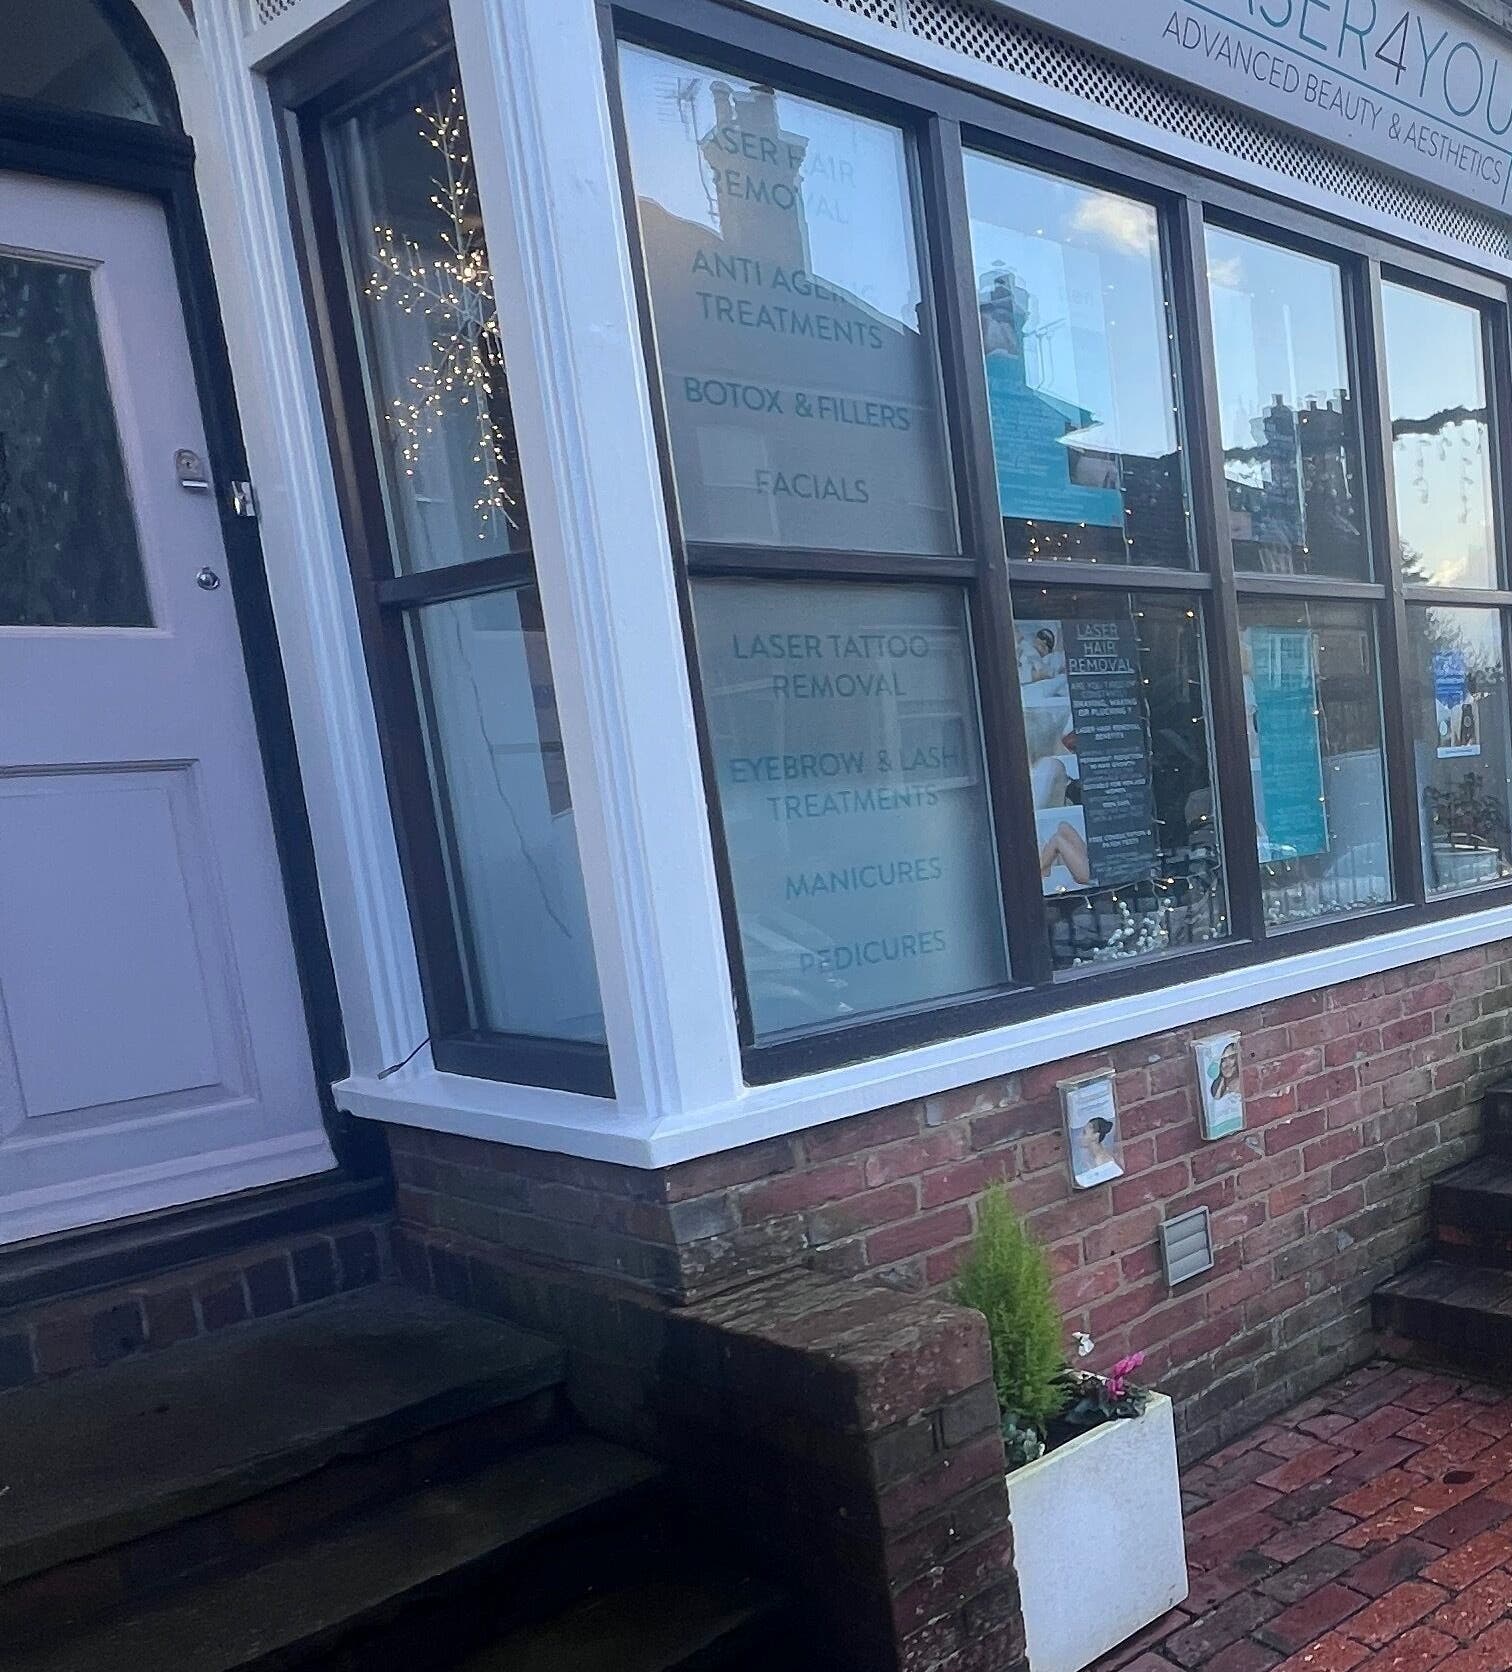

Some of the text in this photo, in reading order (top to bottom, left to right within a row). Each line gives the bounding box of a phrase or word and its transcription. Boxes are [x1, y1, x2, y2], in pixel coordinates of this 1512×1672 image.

[1162, 11, 1503, 185] ADVANCED BEAUTY & AESTHETICS
[692, 125, 778, 164] ASER
[692, 250, 761, 286] ANTI
[695, 291, 883, 349] TREATMENTS
[684, 377, 911, 431] BOTOX & FILLERS
[755, 469, 869, 503] FACIALS
[733, 634, 930, 660] LASER TATTOO
[1076, 623, 1119, 638] LASER
[1083, 641, 1116, 656] HAIR
[1069, 658, 1135, 674] REMOVAL
[772, 672, 907, 700] REMOVAL
[729, 746, 961, 784] EYEBROW & LASH
[767, 784, 939, 822] TREATMENTS
[786, 857, 942, 899] MANICURES
[801, 930, 947, 974] PEDICURES
